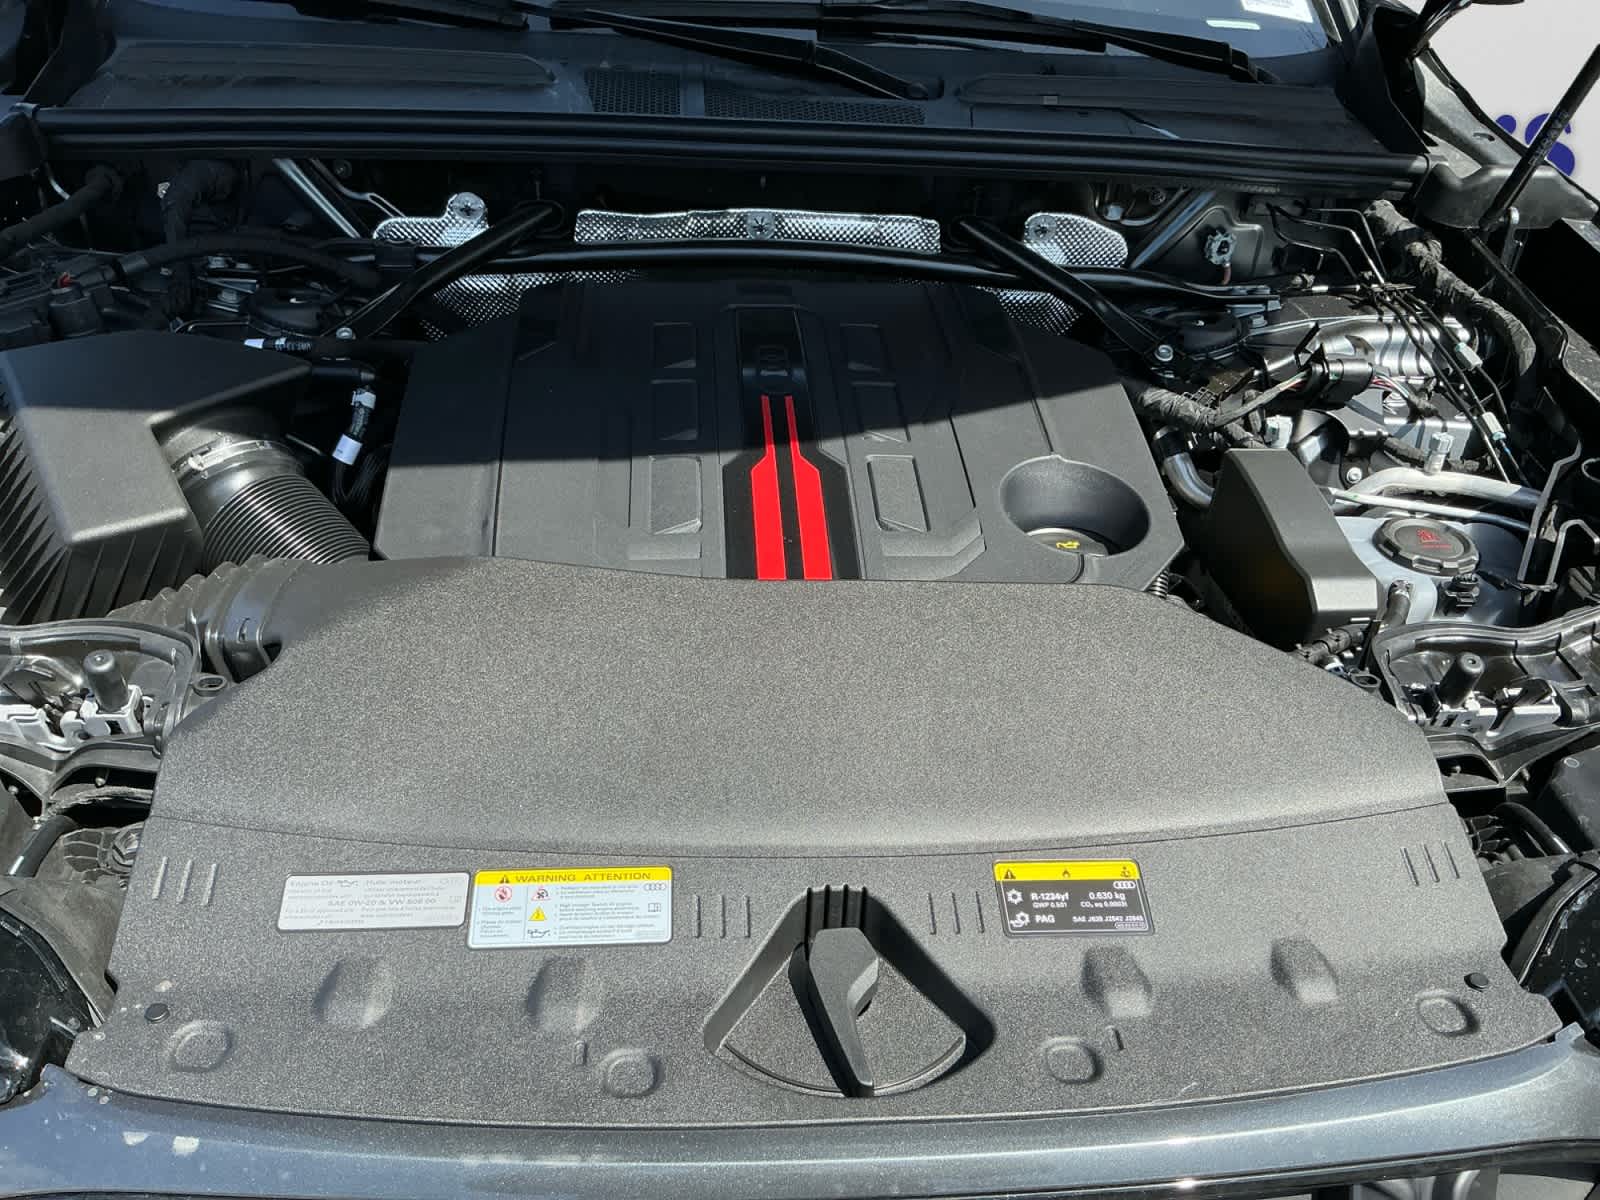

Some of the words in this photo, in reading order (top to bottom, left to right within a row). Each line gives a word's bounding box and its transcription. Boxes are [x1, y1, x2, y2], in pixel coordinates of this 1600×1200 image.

[515, 873, 576, 883] WARNING
[584, 872, 651, 881] ATTENTION
[1031, 892, 1069, 902] R-1234yf
[1089, 892, 1114, 900] 0.630
[1114, 891, 1126, 901] kg
[1035, 914, 1056, 923] PAG
